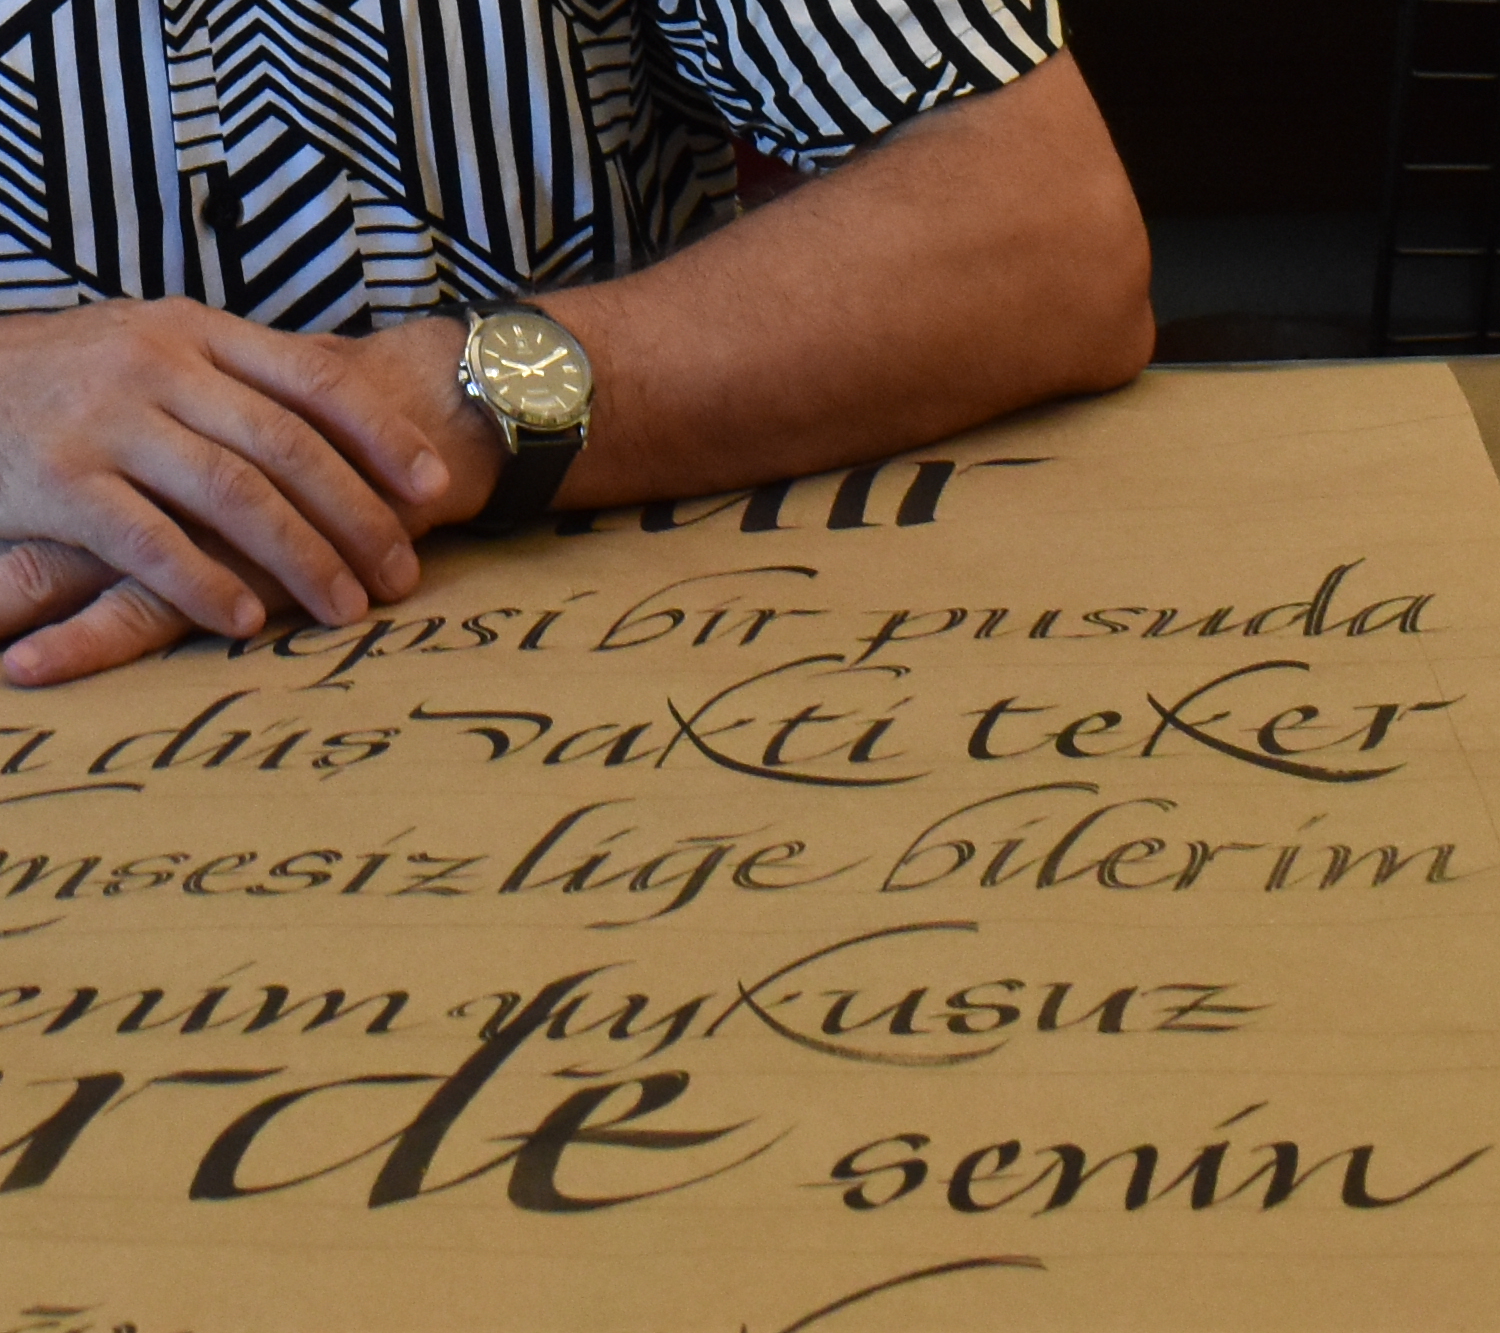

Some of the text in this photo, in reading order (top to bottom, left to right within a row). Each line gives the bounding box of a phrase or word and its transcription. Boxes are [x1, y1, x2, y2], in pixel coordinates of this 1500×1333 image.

[592, 563, 824, 655] bir
[846, 557, 1436, 676] pusuda
[797, 1098, 1494, 1217] senin
